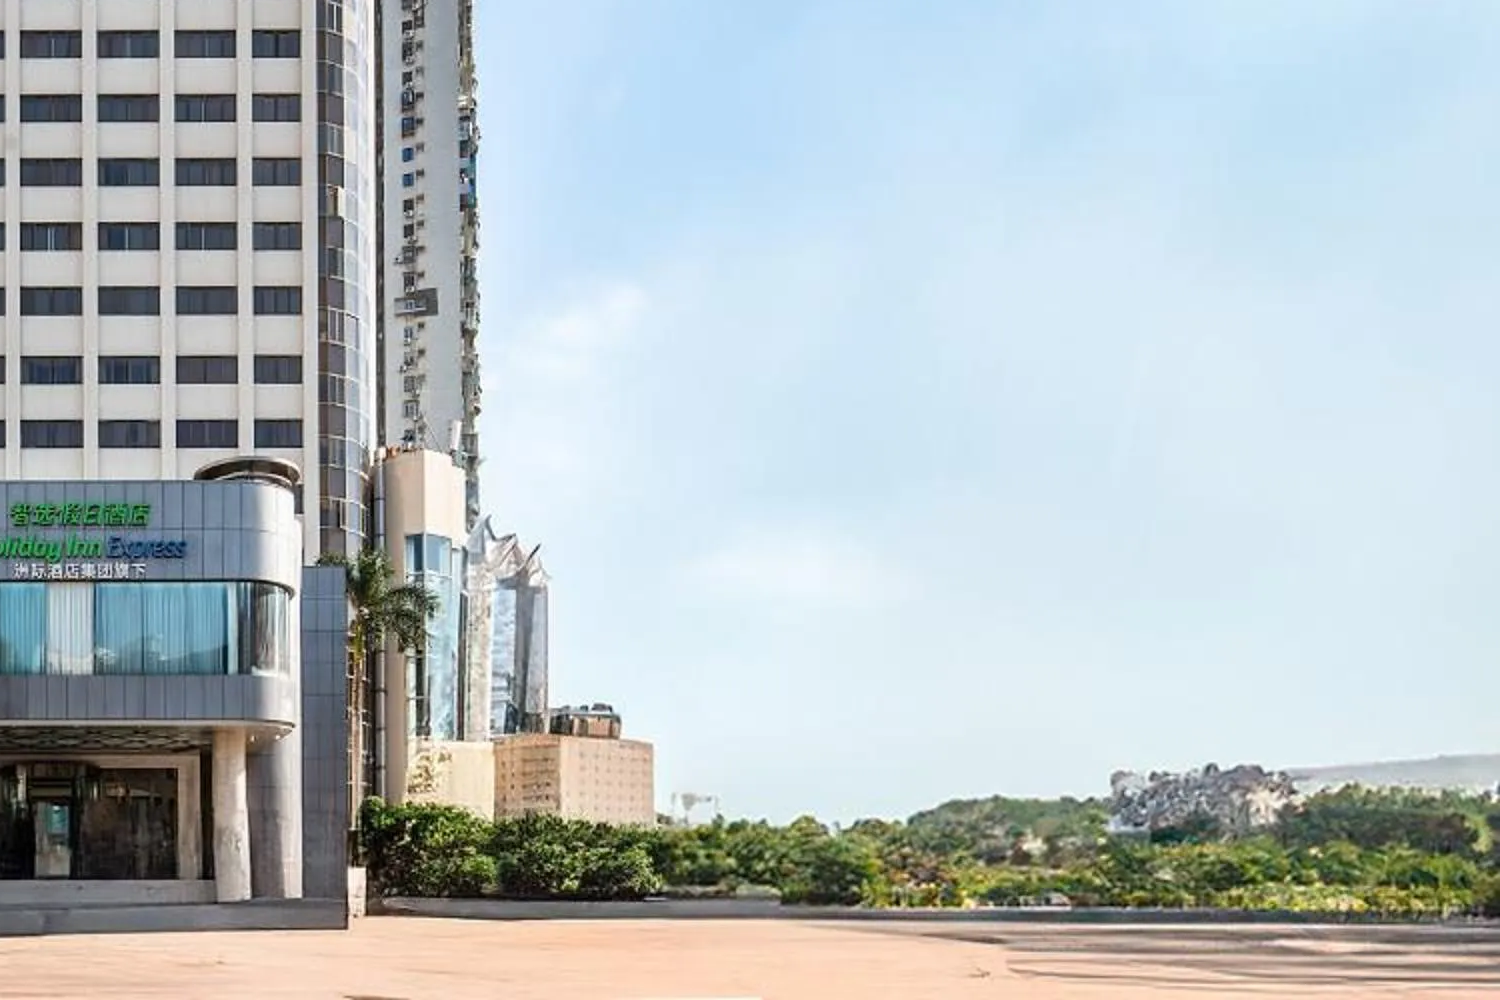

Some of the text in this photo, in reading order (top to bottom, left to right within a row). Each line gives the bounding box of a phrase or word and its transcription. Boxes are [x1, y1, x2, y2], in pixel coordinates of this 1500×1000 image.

[65, 534, 102, 558] Inn
[105, 536, 188, 561] Express
[13, 563, 147, 579] 洲际酒店集团旗下
